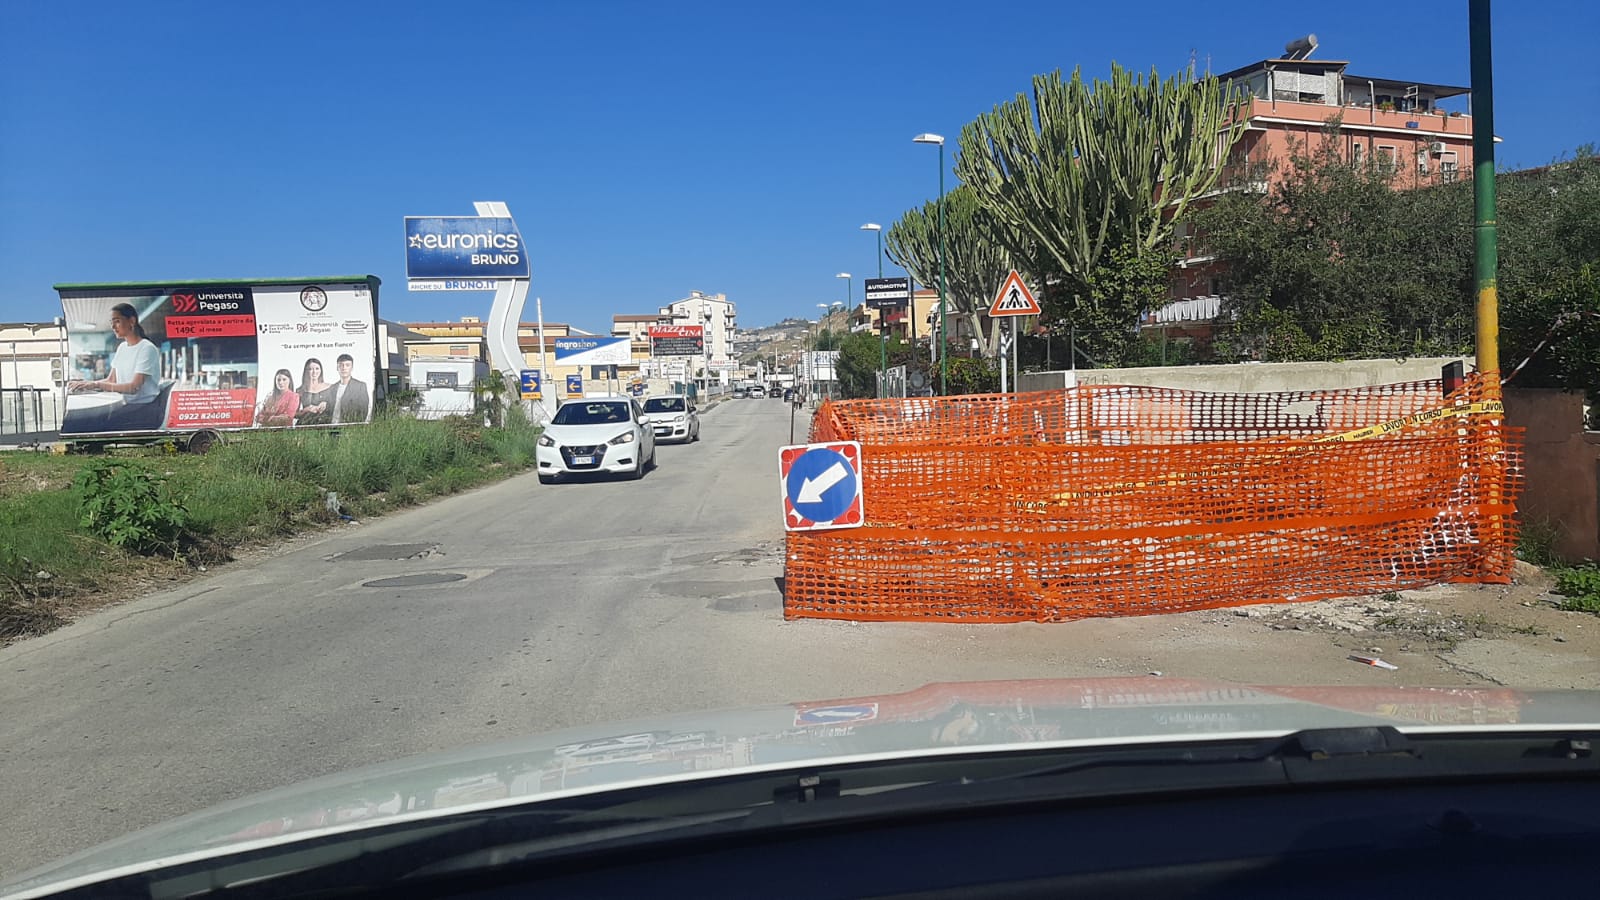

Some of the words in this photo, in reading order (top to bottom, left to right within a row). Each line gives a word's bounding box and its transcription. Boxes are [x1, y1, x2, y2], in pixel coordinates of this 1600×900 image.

[423, 230, 518, 248] euronics
[471, 254, 519, 265] BRUNO
[445, 280, 497, 289] BRUNO.IT
[200, 302, 239, 311] Pegaso
[556, 340, 598, 350] ingroshop
[1418, 408, 1443, 423] CORSO
